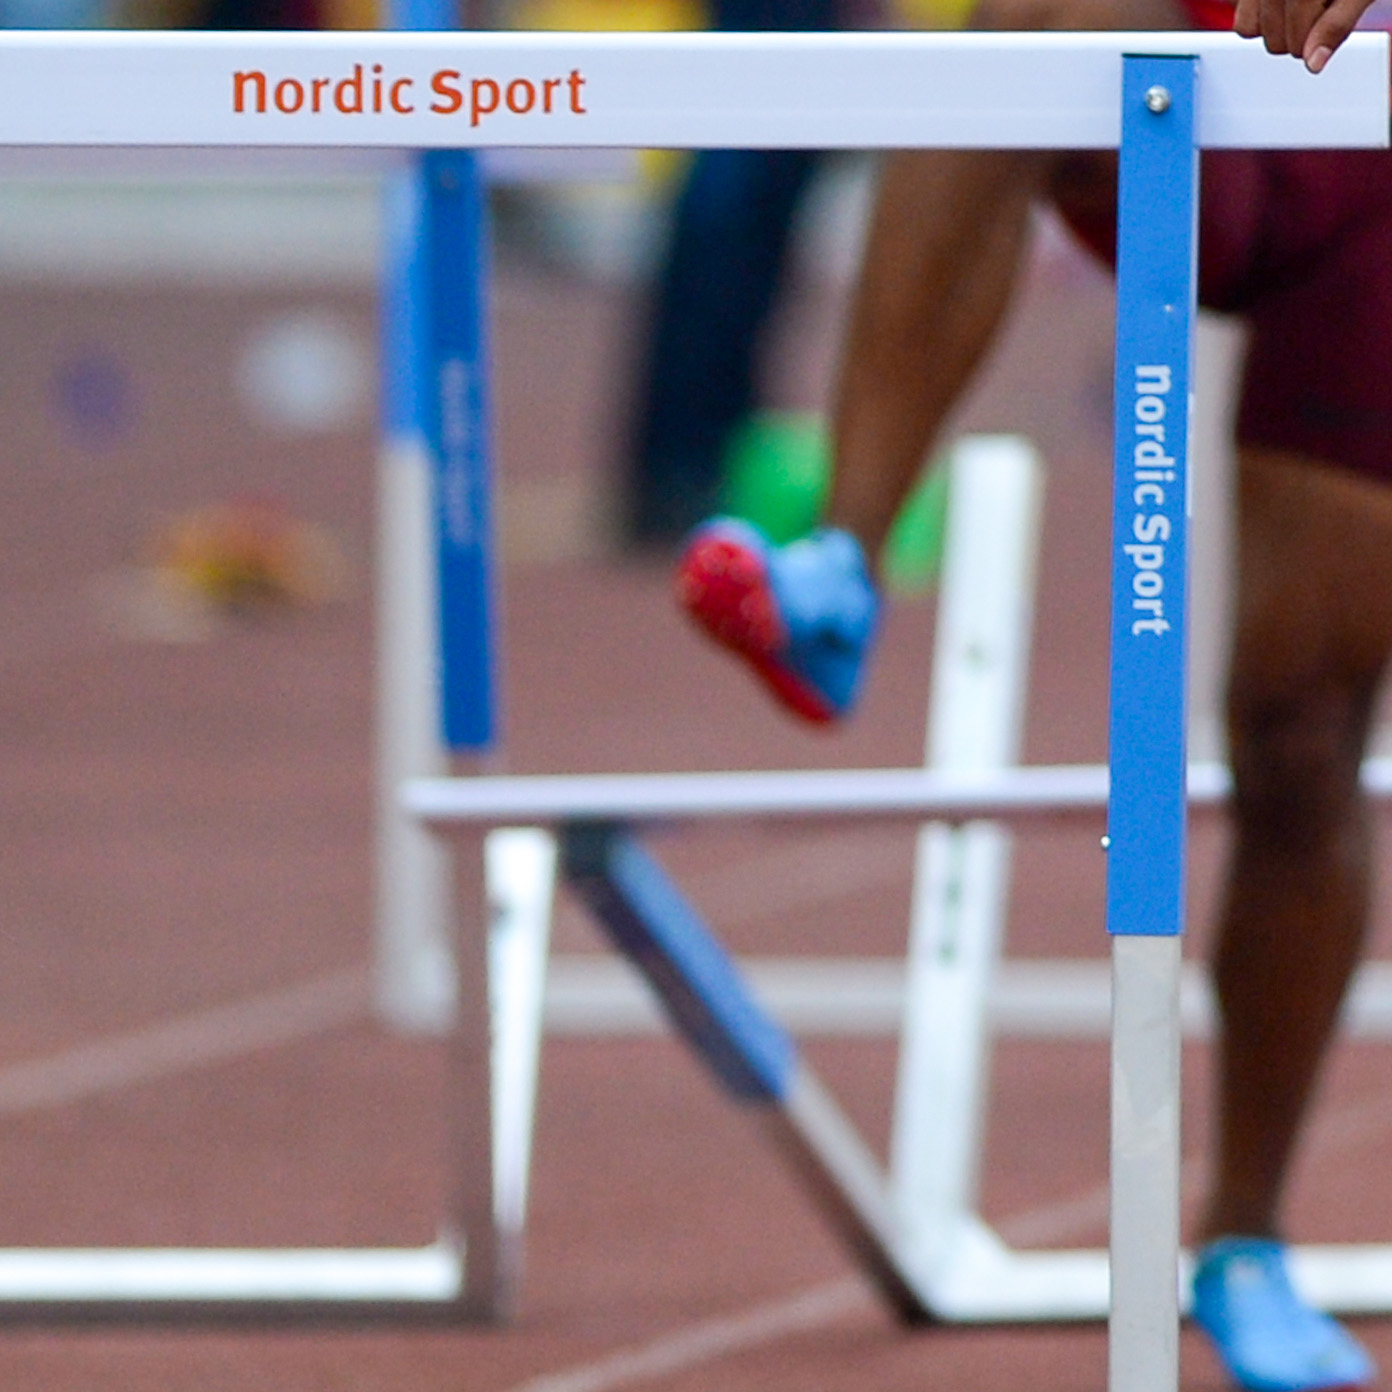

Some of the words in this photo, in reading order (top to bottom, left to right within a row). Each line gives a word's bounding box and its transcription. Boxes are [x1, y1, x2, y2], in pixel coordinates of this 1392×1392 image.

[232, 63, 415, 114] nordic
[430, 68, 586, 127] Sport
[1135, 366, 1174, 504] nordic
[1124, 514, 1170, 635] Sport
